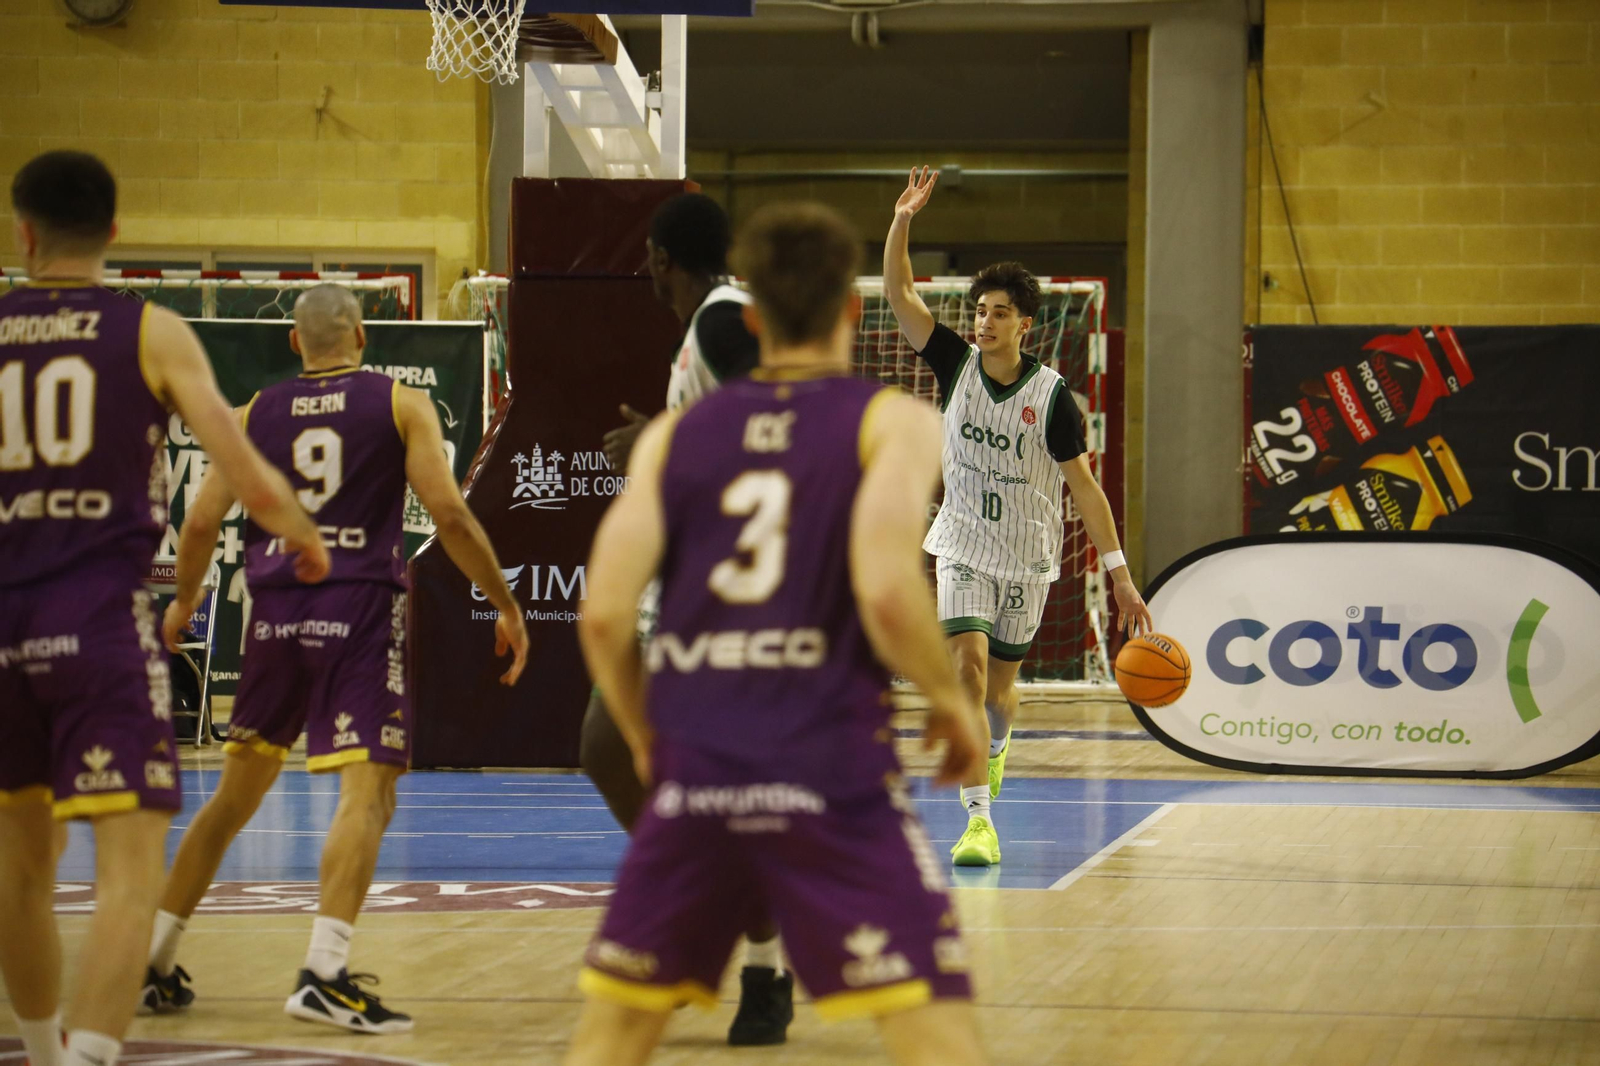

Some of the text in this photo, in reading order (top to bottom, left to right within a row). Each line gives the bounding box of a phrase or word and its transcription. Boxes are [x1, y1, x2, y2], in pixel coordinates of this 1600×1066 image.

[291, 391, 346, 417] ISERN
[1331, 371, 1371, 439] CHOCOLATE
[1357, 360, 1396, 424] PROTEIN
[0, 355, 98, 471] 10
[961, 421, 1010, 452] coto
[292, 426, 343, 515] 9
[570, 451, 615, 471] AYUN
[571, 477, 590, 497] DE
[981, 489, 1002, 522] 10
[707, 468, 792, 604] 3
[530, 565, 588, 601] IM
[274, 620, 350, 640] HYUNDAI
[645, 627, 827, 673] IVECO
[1206, 606, 1478, 691] coto
[1199, 713, 1472, 745] Contigo, con todo.
